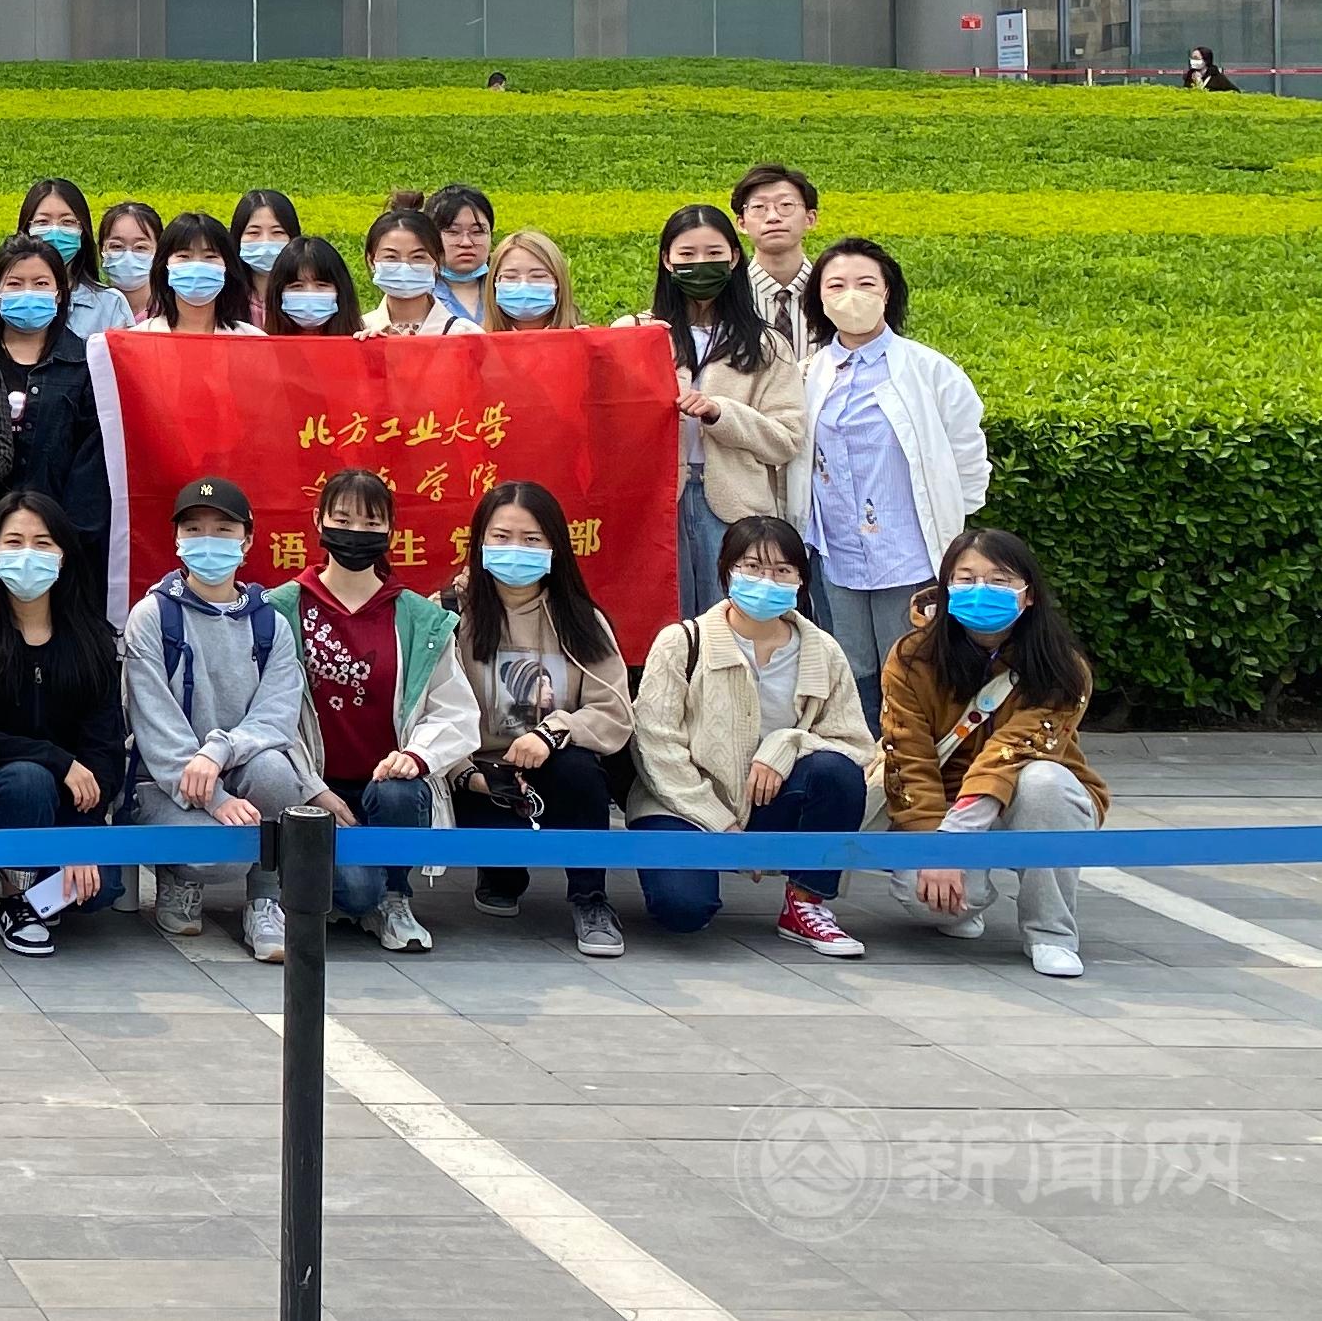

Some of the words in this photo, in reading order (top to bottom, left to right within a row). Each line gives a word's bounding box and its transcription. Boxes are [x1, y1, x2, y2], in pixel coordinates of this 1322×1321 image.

[299, 400, 511, 450] 北方工业大学
